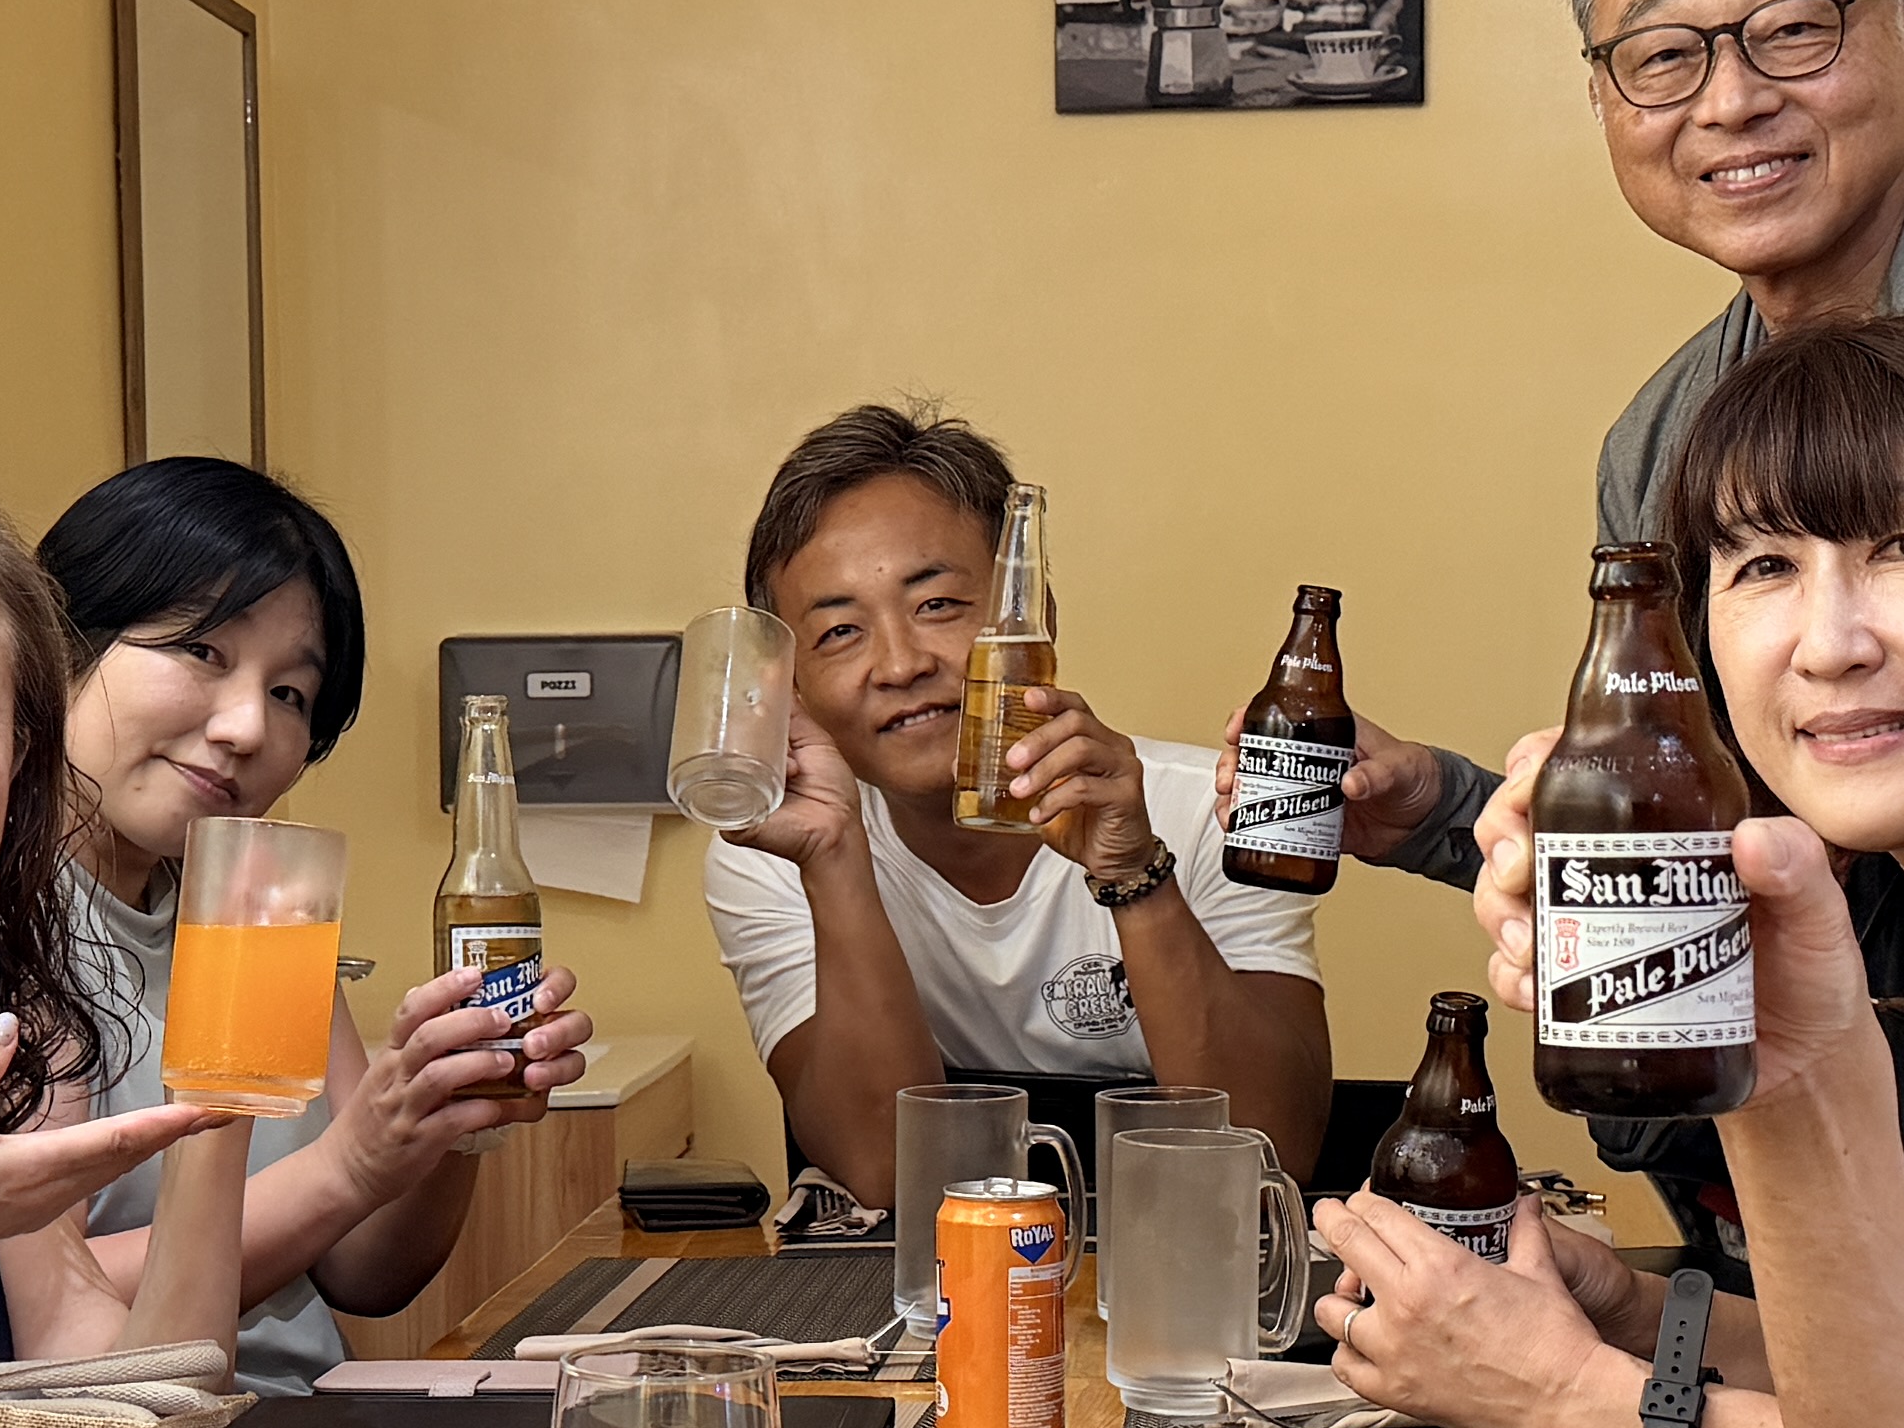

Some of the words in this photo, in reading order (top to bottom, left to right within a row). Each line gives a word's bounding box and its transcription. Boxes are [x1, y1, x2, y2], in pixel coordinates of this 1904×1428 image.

[1605, 672, 1647, 696] Pale
[1650, 671, 1699, 694] Pilsen
[1238, 748, 1268, 774] San
[1267, 751, 1342, 785] Miguel
[1236, 806, 1271, 831] Pale
[1272, 793, 1331, 821] Pilsen
[1561, 858, 1647, 905] San
[1648, 858, 1751, 907] Migu
[1587, 959, 1666, 1017] Pale
[1669, 922, 1752, 989] Pilsen
[1461, 1095, 1486, 1115] Pale
